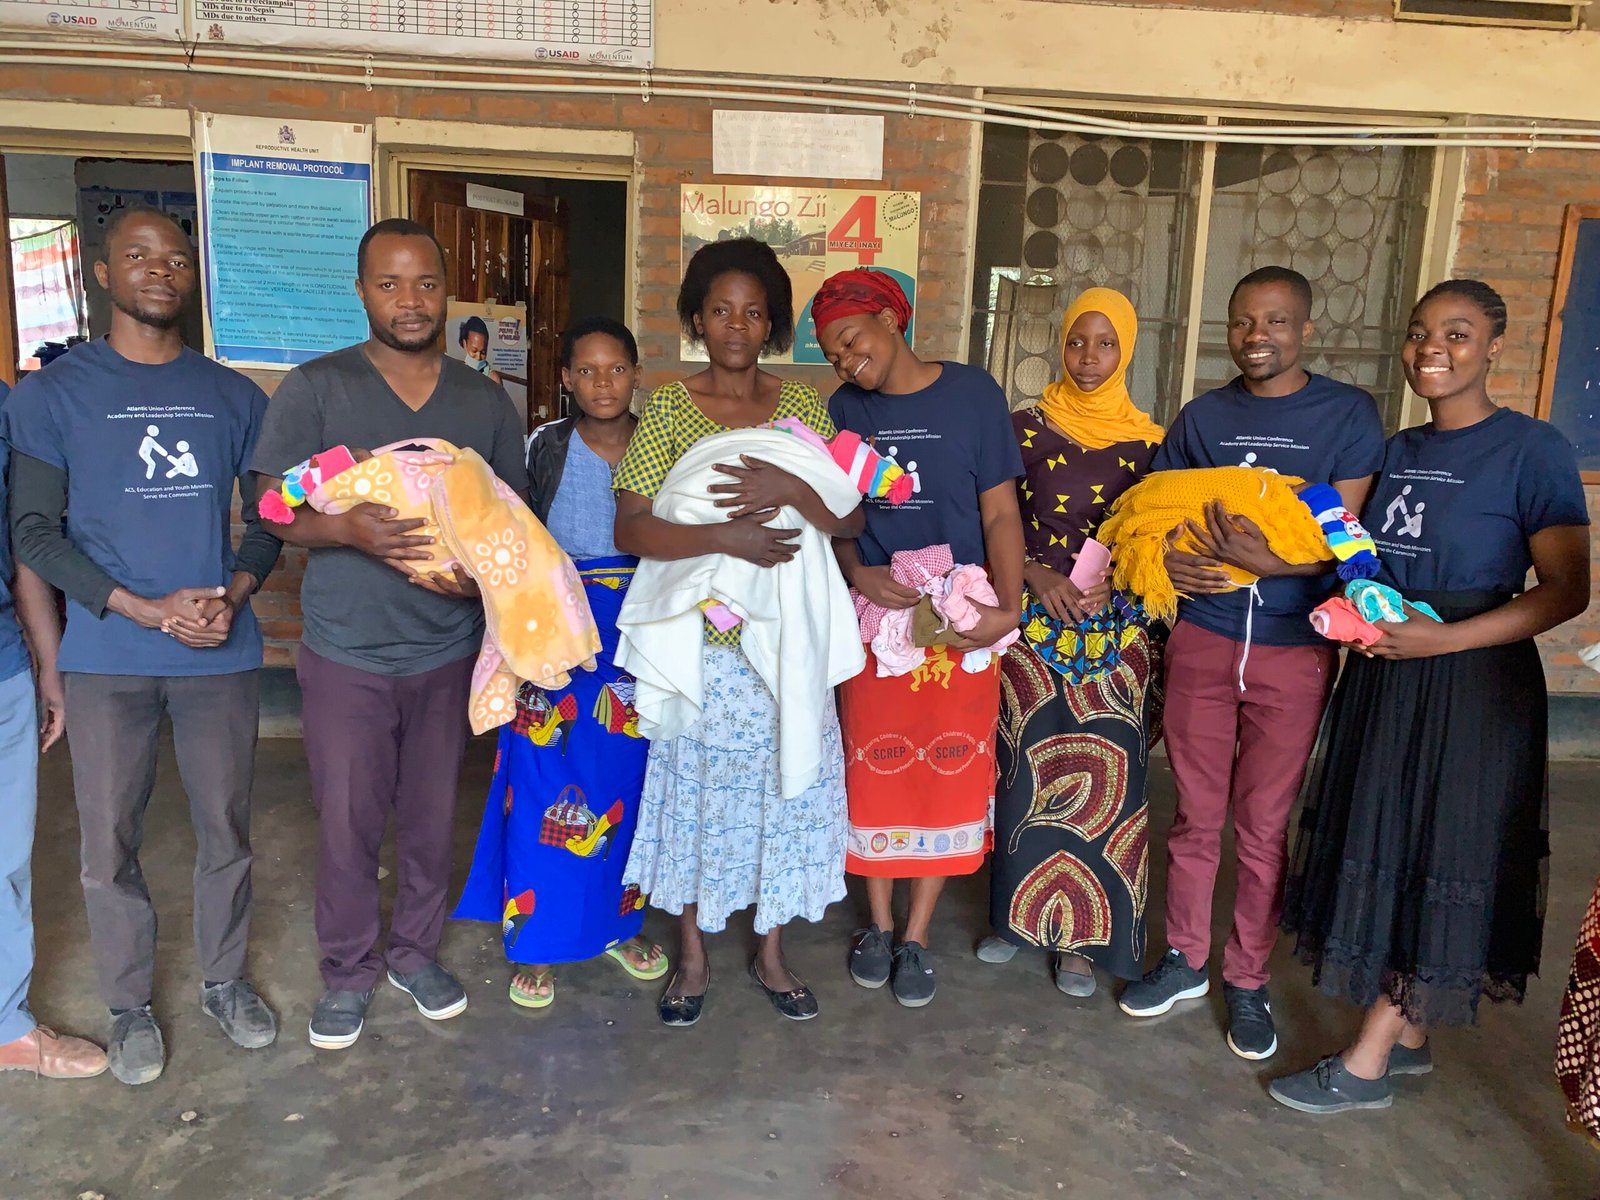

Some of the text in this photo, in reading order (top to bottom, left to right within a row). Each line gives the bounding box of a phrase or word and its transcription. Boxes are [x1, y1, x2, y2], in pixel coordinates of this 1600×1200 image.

[253, 7, 275, 15] Sepsis
[63, 15, 97, 26] USAID
[108, 17, 157, 29] MOMENTUM
[549, 50, 580, 59] USAID
[589, 51, 632, 60] MOMENTUM
[256, 144, 289, 152] REPRODUCTIVE
[231, 158, 344, 175] IMPLANT REMOVAL PROTOCOL
[682, 186, 827, 223] Malungo Zii
[827, 195, 883, 266] 4
[1392, 549, 1417, 558] Community
[873, 746, 906, 760] SCREP
[935, 744, 968, 759] SCREP
